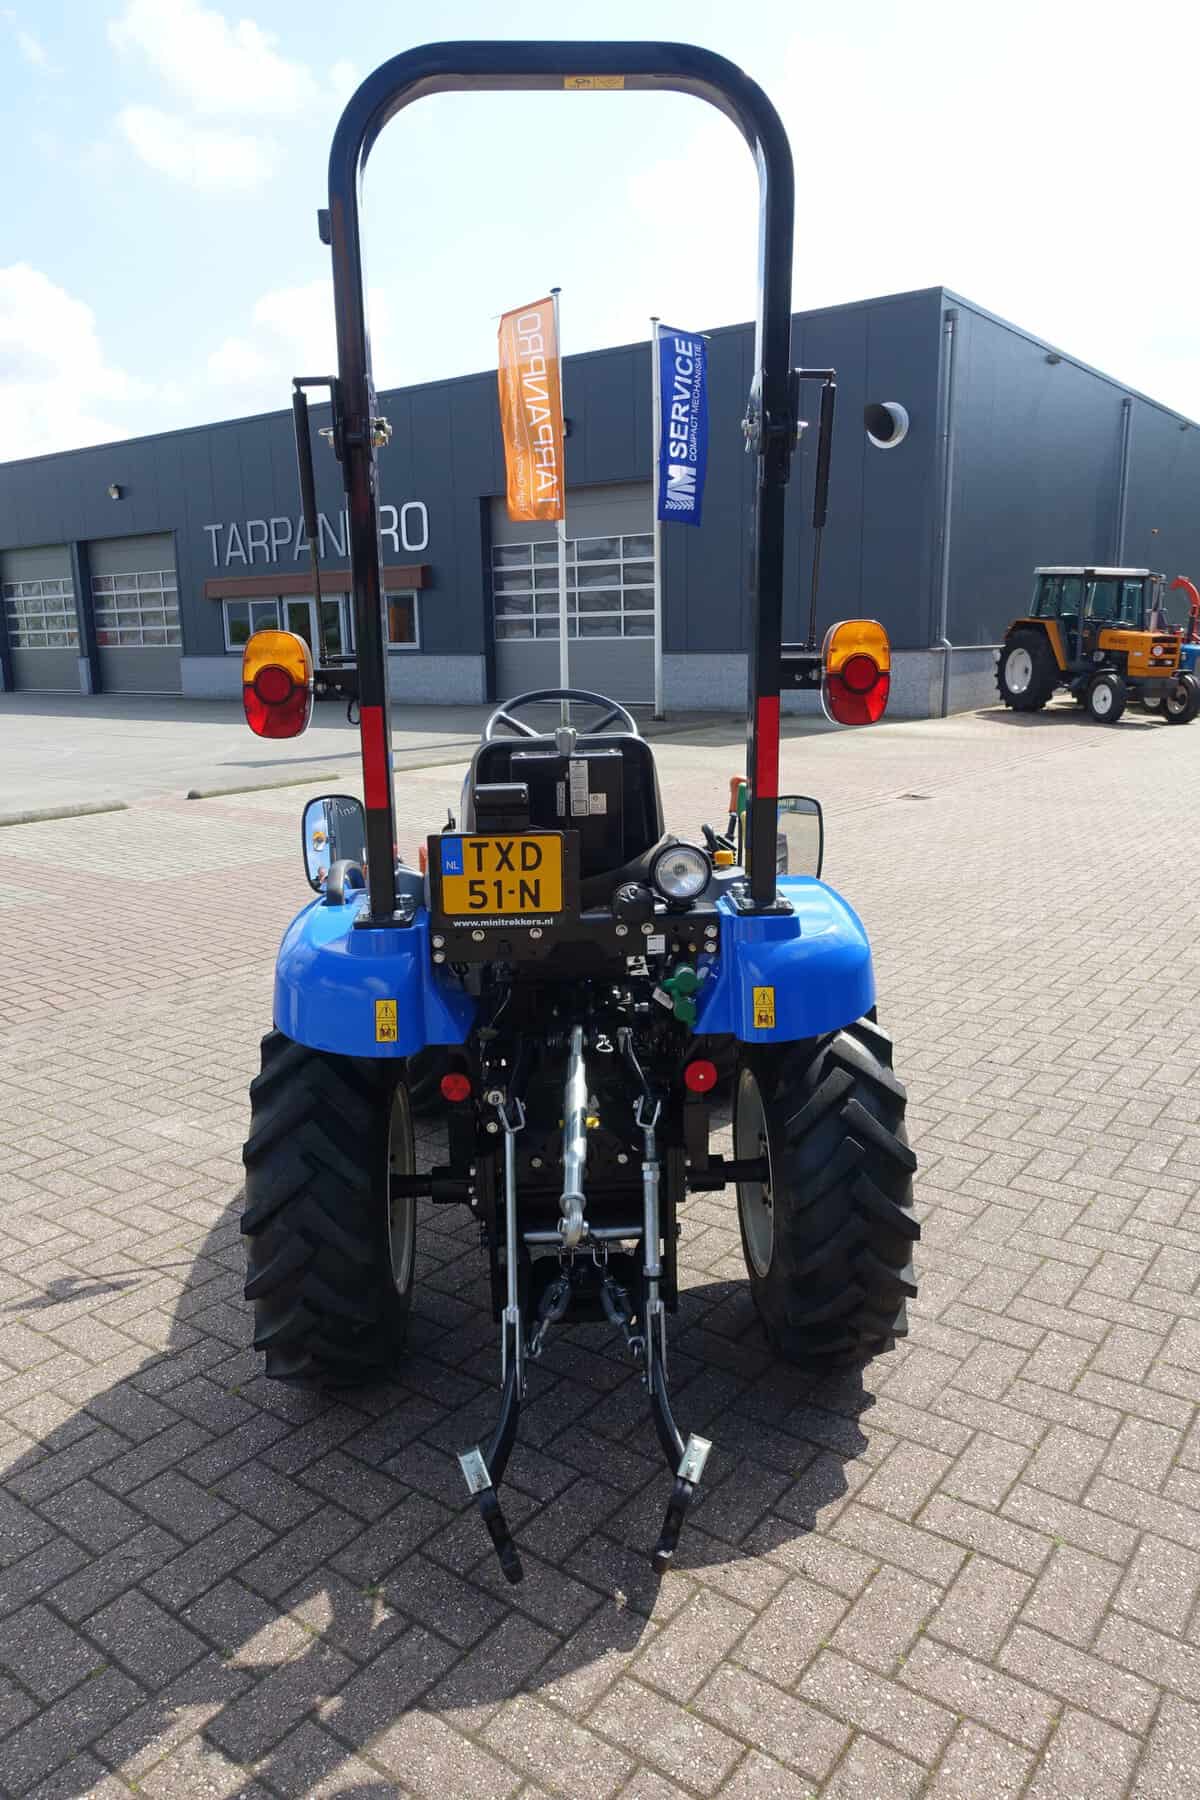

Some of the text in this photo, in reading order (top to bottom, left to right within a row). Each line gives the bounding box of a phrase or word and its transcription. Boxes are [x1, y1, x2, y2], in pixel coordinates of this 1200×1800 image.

[670, 338, 693, 459] SERVICE
[688, 344, 702, 462] COMPACT MECHANISATIE
[203, 501, 429, 566] TARPANRO
[446, 861, 459, 870] NL
[469, 841, 542, 873] TXD
[468, 879, 540, 909] 51-N
[453, 917, 553, 928] www.minitrekkers.nl
